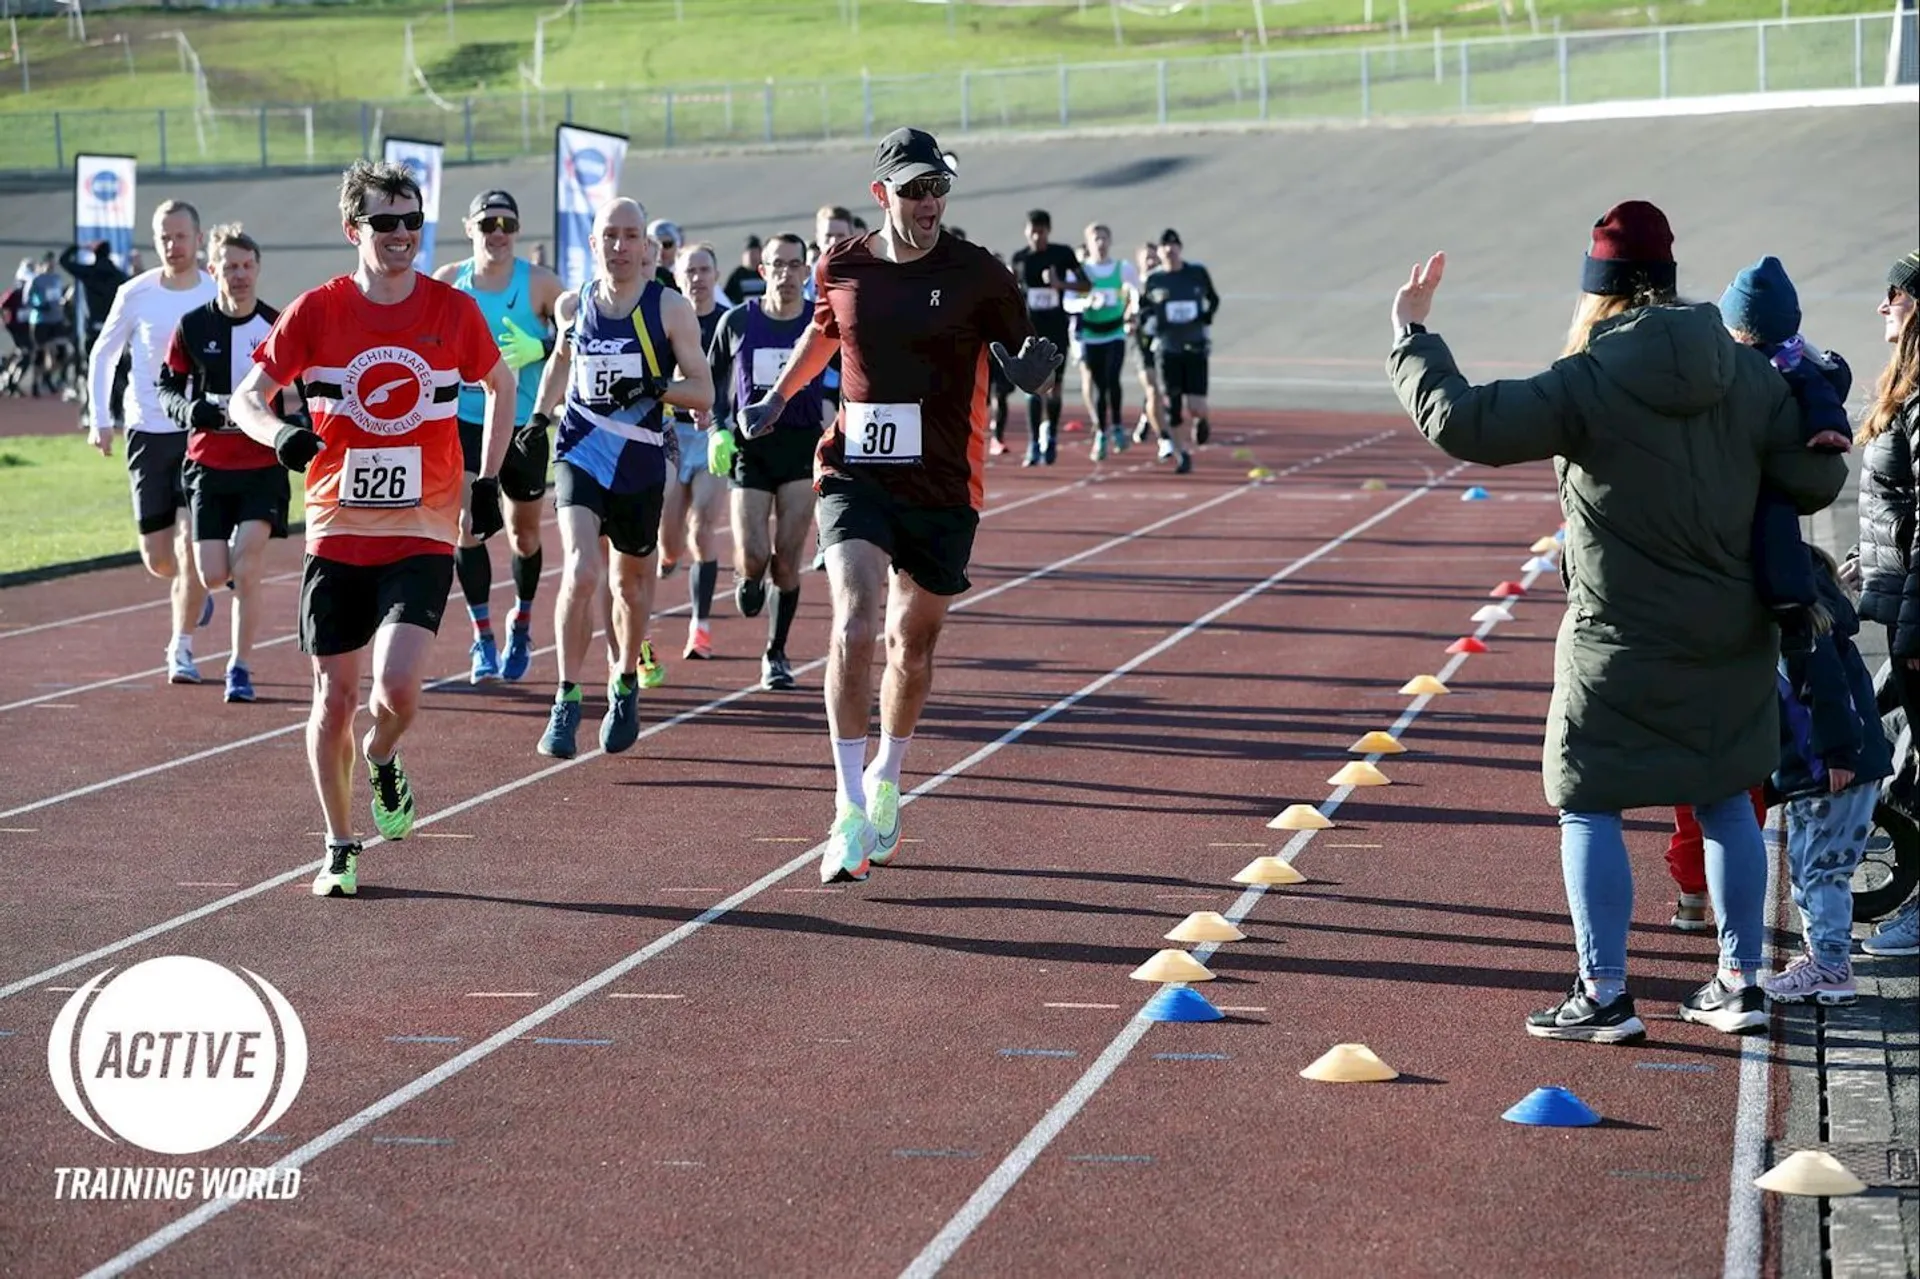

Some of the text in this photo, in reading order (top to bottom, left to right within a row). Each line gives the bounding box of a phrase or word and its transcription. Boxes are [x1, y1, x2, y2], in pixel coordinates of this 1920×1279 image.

[345, 349, 432, 387] HITCHIN HARES
[348, 399, 422, 433] RUNNING CLUB
[862, 422, 897, 455] 30
[352, 466, 407, 499] 526
